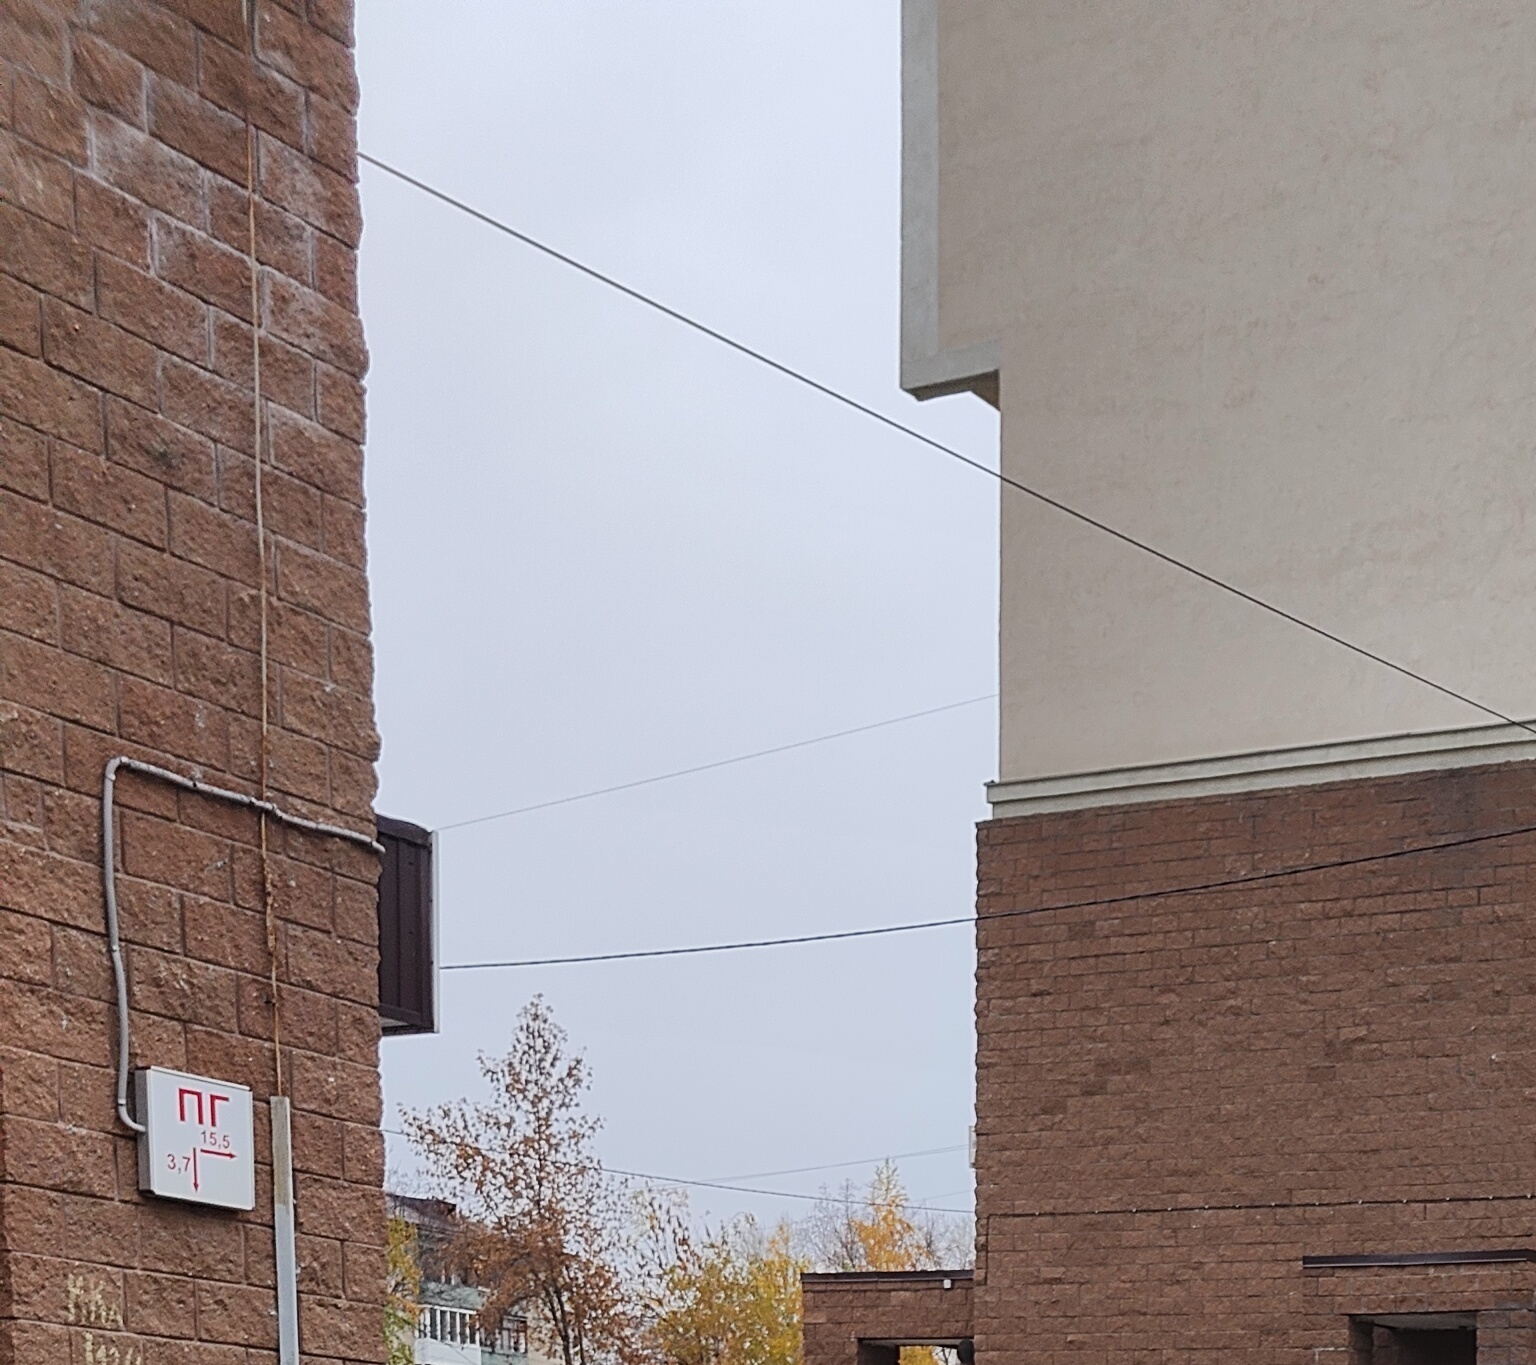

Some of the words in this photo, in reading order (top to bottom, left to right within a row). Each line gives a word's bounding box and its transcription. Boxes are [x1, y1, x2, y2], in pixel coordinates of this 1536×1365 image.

[178, 1087, 229, 1128] ПГ
[201, 1130, 230, 1150] 15,5
[167, 1153, 190, 1174] 3,7
